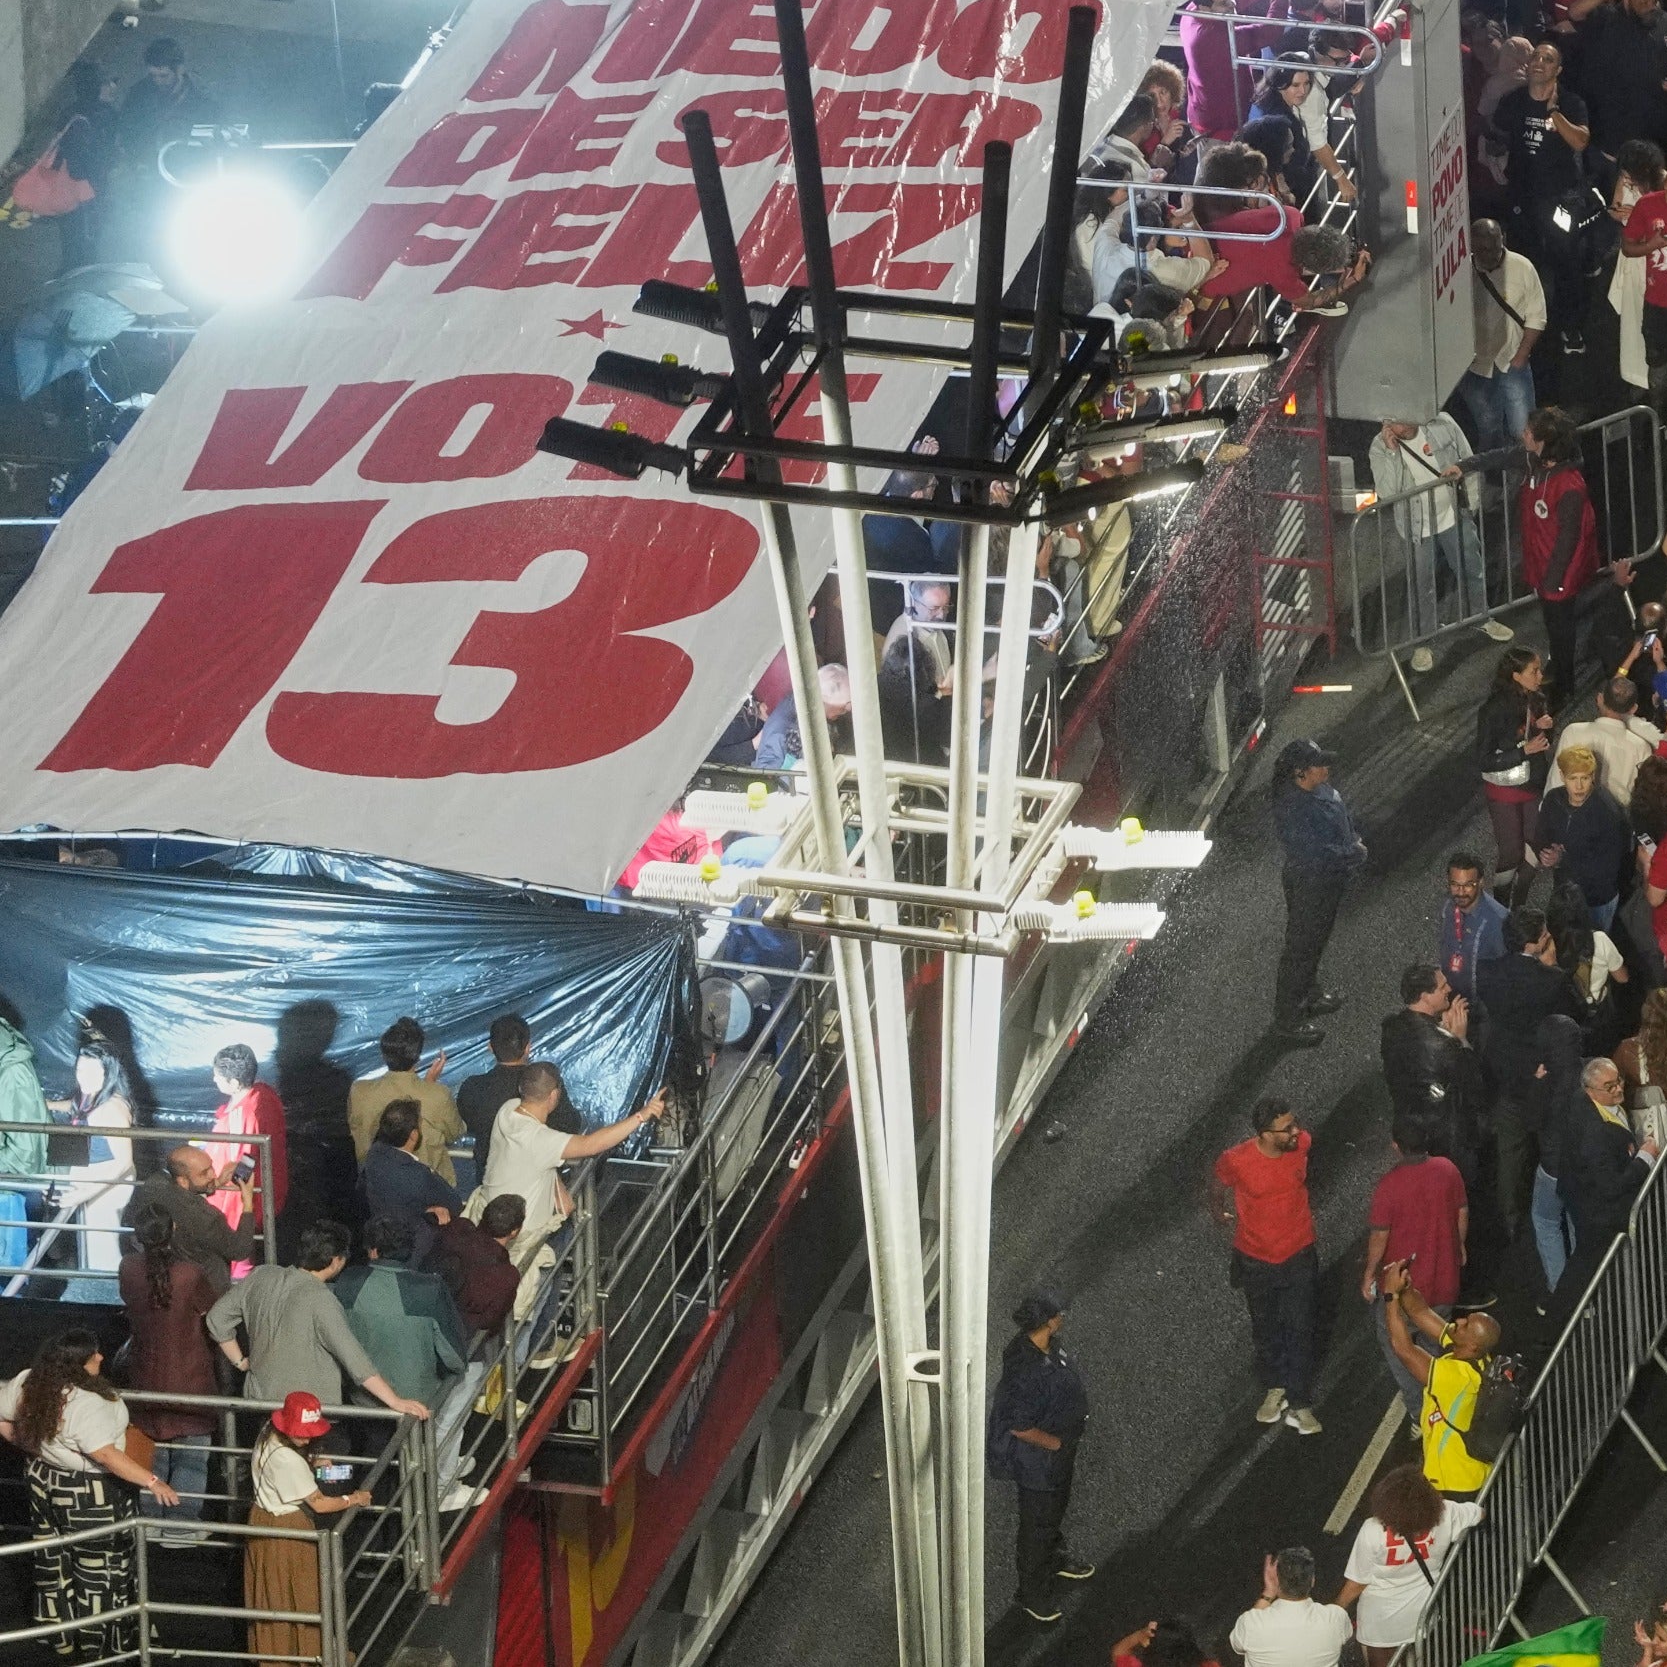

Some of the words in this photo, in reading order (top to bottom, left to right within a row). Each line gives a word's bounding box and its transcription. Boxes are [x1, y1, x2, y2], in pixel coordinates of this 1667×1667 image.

[385, 86, 662, 188] DE
[655, 87, 1042, 169] SER
[1431, 135, 1451, 176] TIME
[1432, 145, 1464, 222] POVO
[292, 182, 986, 301] FELIZ
[1434, 203, 1455, 254] TIME
[1435, 226, 1468, 302] LULA
[36, 495, 761, 779] 13
